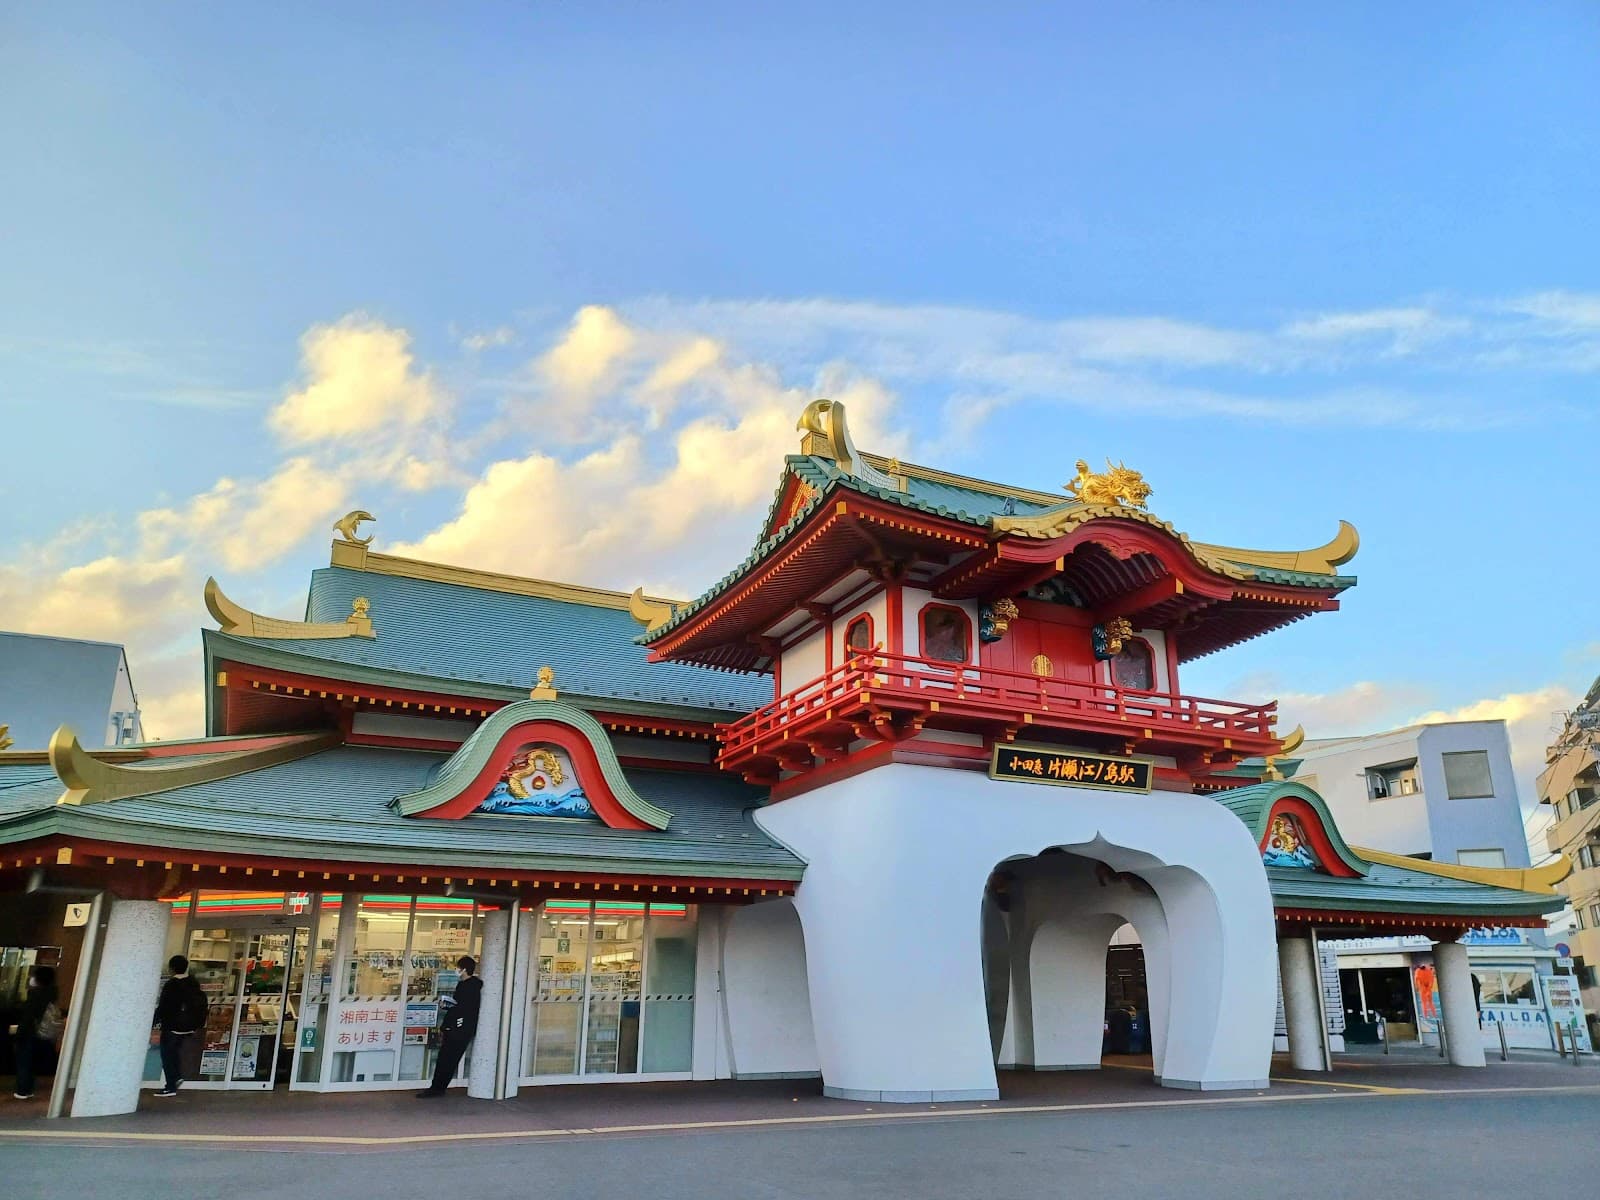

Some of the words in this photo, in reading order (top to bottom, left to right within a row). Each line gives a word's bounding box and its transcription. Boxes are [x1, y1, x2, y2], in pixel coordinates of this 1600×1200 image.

[1009, 756, 1044, 775] 小田急
[340, 1008, 399, 1025] 湘南土産
[338, 1029, 396, 1045] あります
